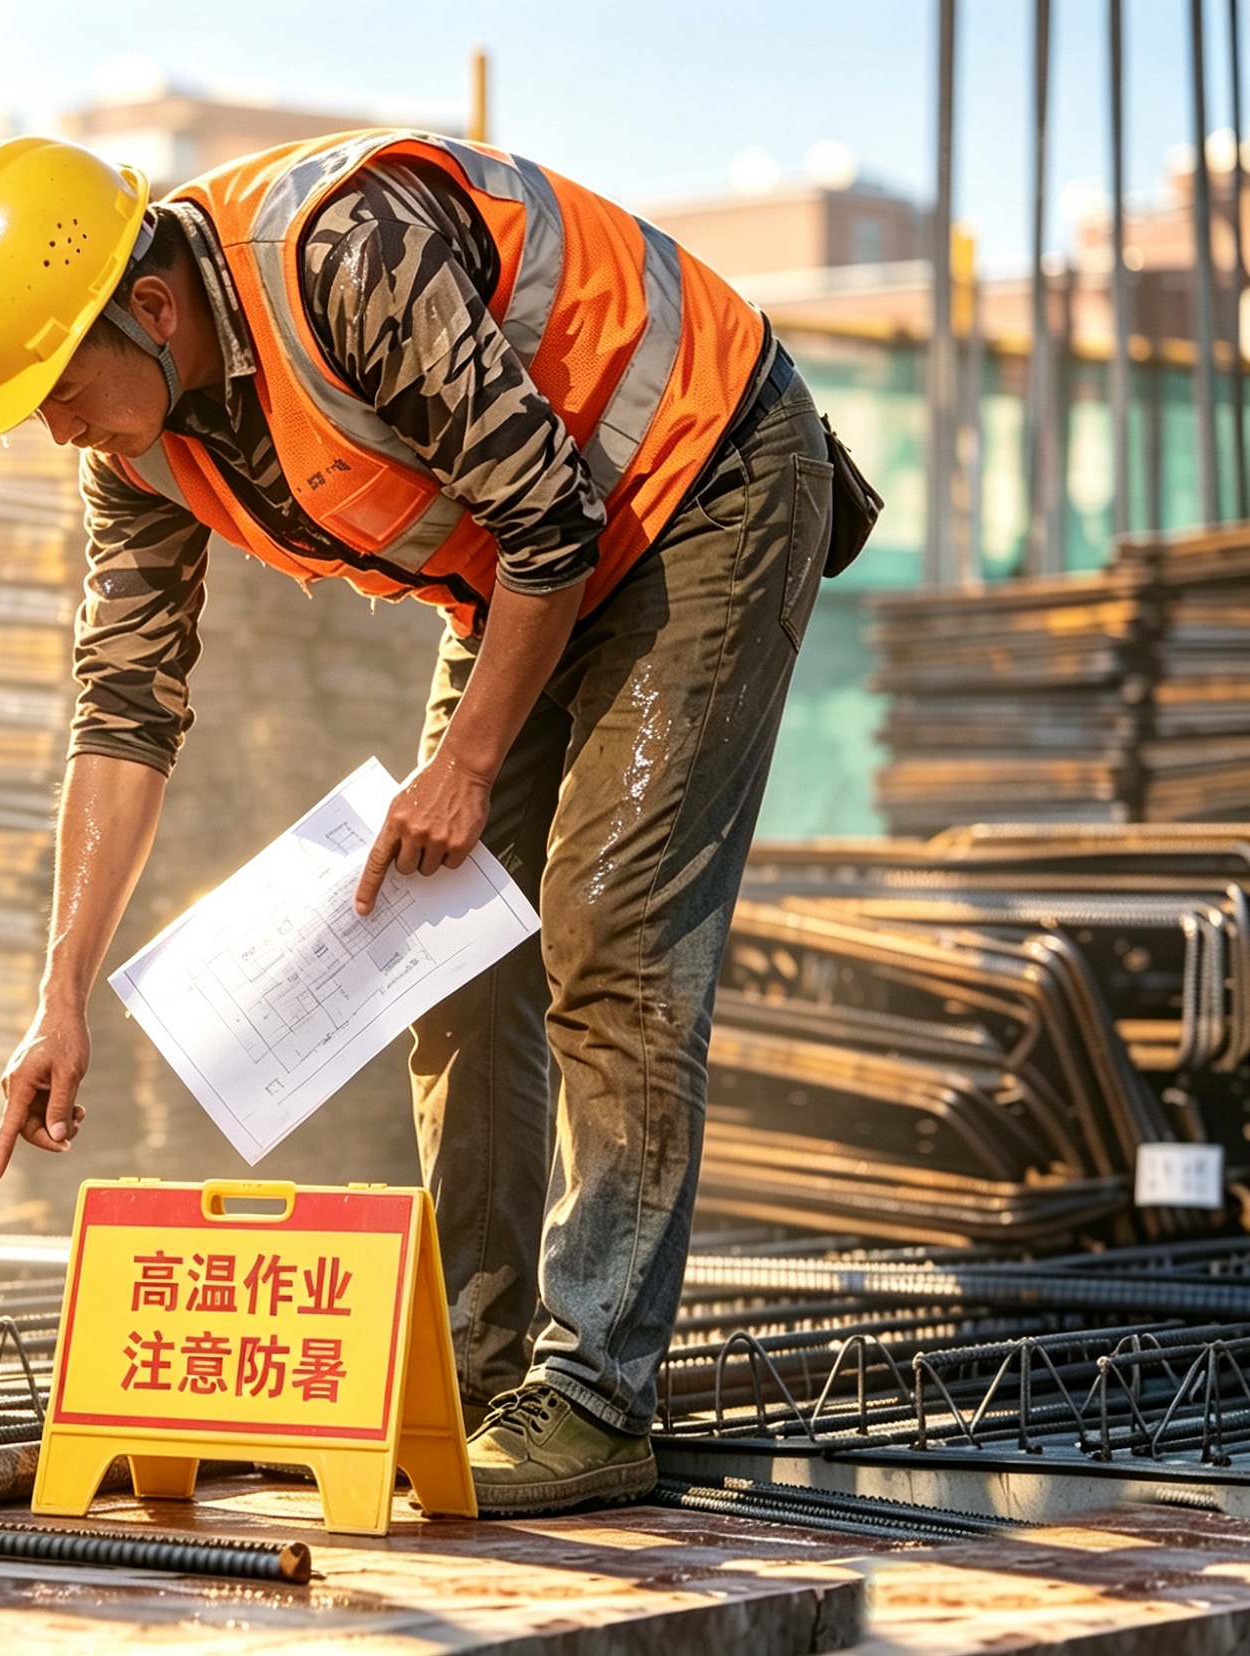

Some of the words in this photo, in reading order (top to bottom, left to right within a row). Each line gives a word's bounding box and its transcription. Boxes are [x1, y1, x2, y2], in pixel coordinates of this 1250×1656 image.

[130, 1249, 353, 1317] 高温作业
[120, 1330, 347, 1404] 注意防暑
